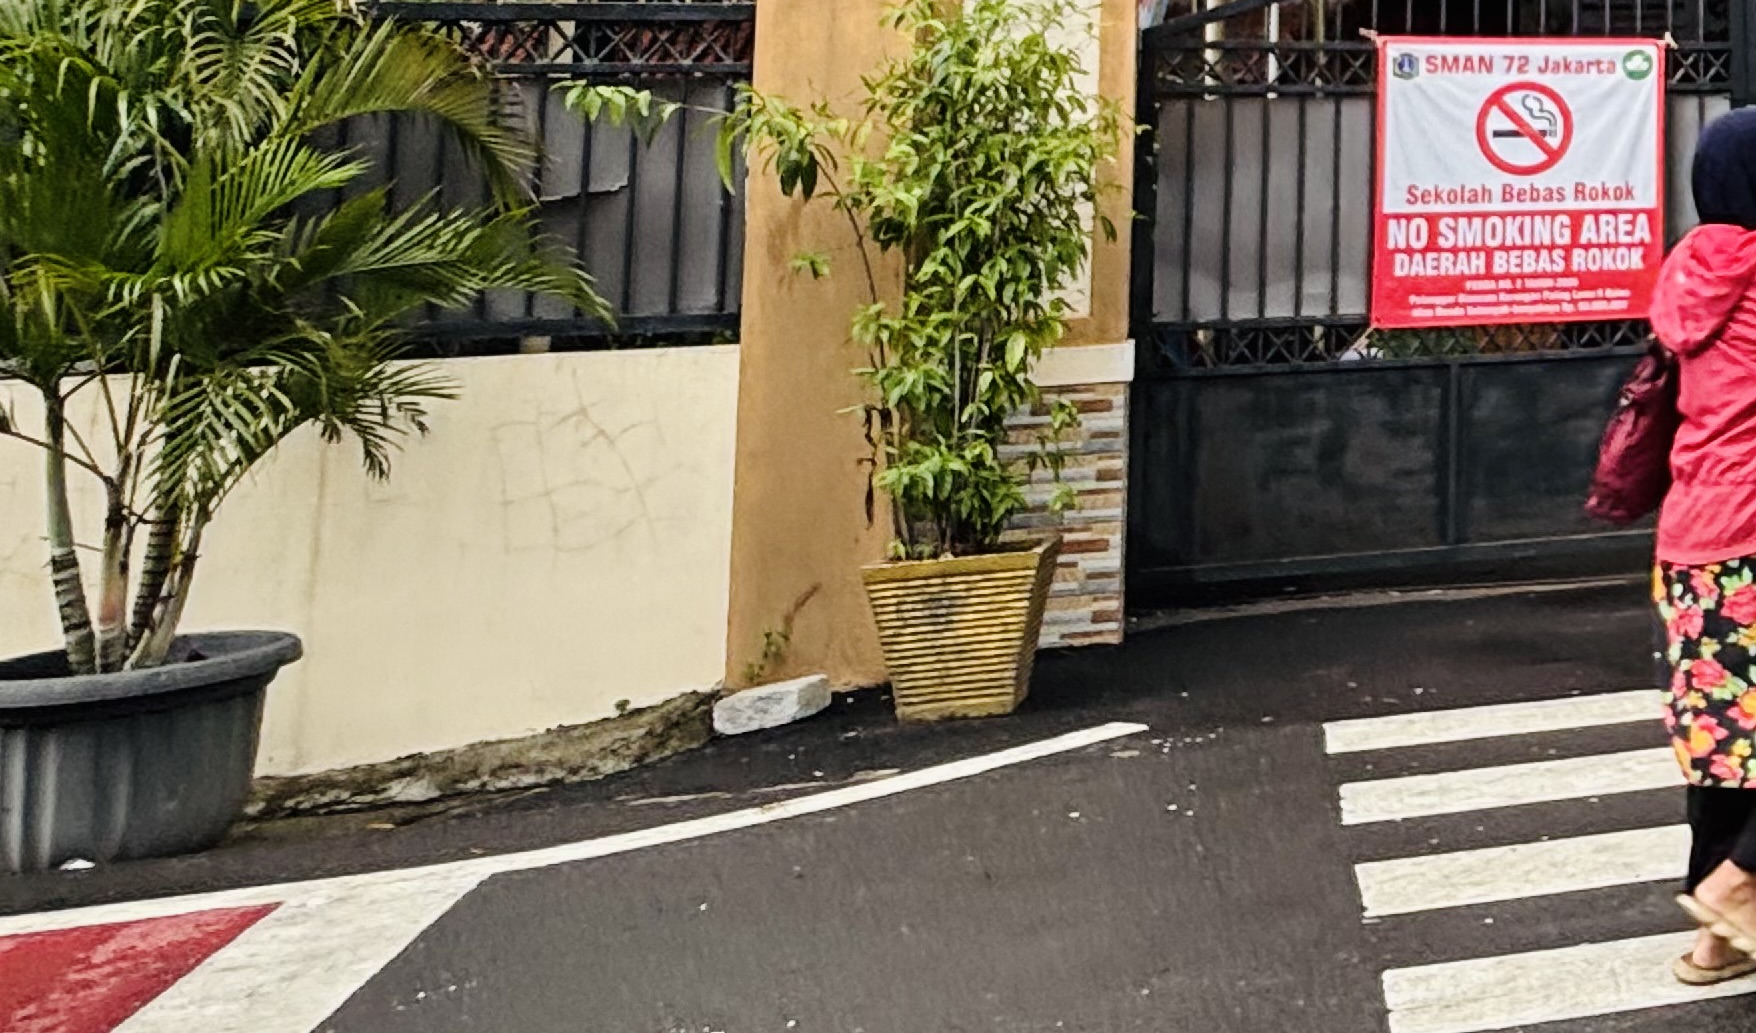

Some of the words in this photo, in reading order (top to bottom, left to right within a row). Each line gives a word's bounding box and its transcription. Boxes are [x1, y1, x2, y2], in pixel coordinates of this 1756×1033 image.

[1425, 54, 1495, 75] SMAN
[1502, 54, 1530, 74] 72
[1537, 55, 1617, 75] Jakarta
[1406, 183, 1493, 206] Sekolah
[1501, 182, 1567, 204] Bebas
[1573, 180, 1636, 203] Rokok
[1386, 217, 1429, 250] NO
[1437, 214, 1572, 249] SMOKING
[1579, 212, 1652, 245] AREA
[1393, 251, 1486, 277] DAERAH
[1492, 249, 1567, 274] BEBAS
[1571, 246, 1645, 272] ROKOK
